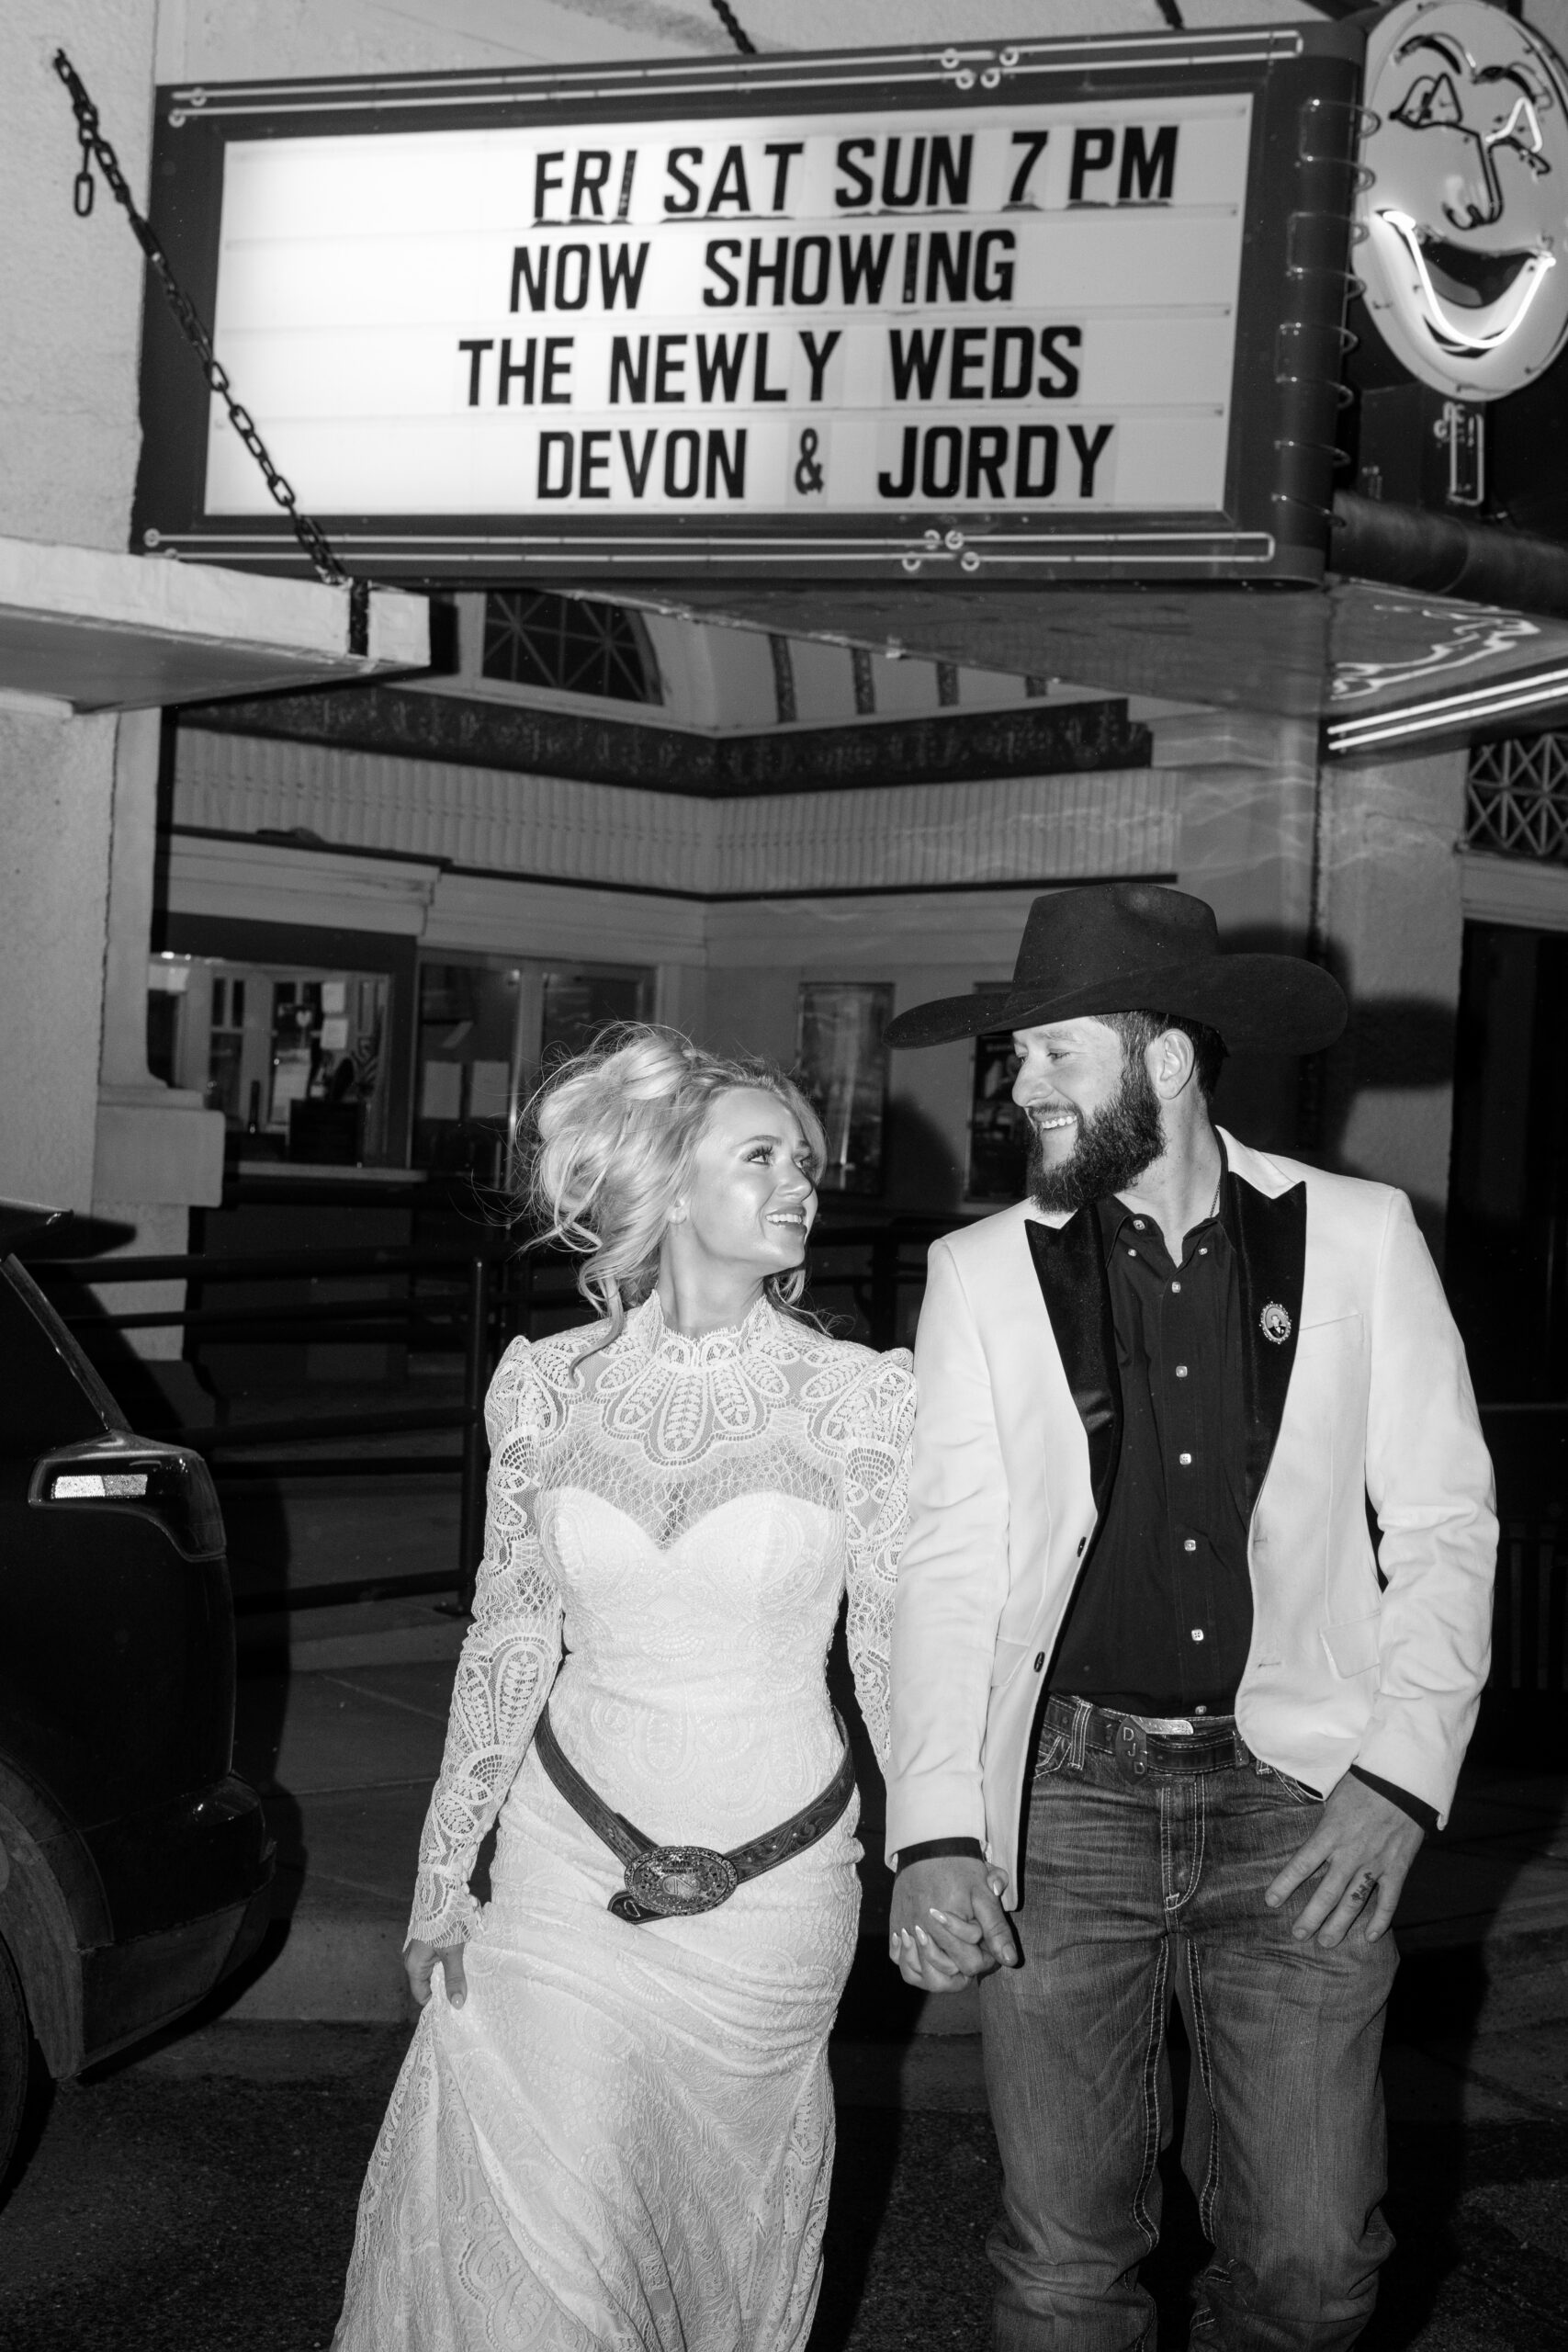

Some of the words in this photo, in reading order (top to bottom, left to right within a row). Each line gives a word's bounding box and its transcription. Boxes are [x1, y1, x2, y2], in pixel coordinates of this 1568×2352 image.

[533, 150, 637, 220] FRI
[664, 141, 805, 213] SAT
[835, 133, 975, 209] SUN
[1008, 130, 1050, 202] 7
[1067, 125, 1179, 202] PM
[510, 242, 649, 312] NOW
[703, 229, 1017, 307] SHOWING
[458, 337, 574, 406] THE
[609, 330, 842, 403] NEWLY
[888, 324, 1083, 401] WEDS
[537, 427, 747, 499] DEVON
[794, 427, 825, 495] &
[877, 424, 1115, 500] JORDY
